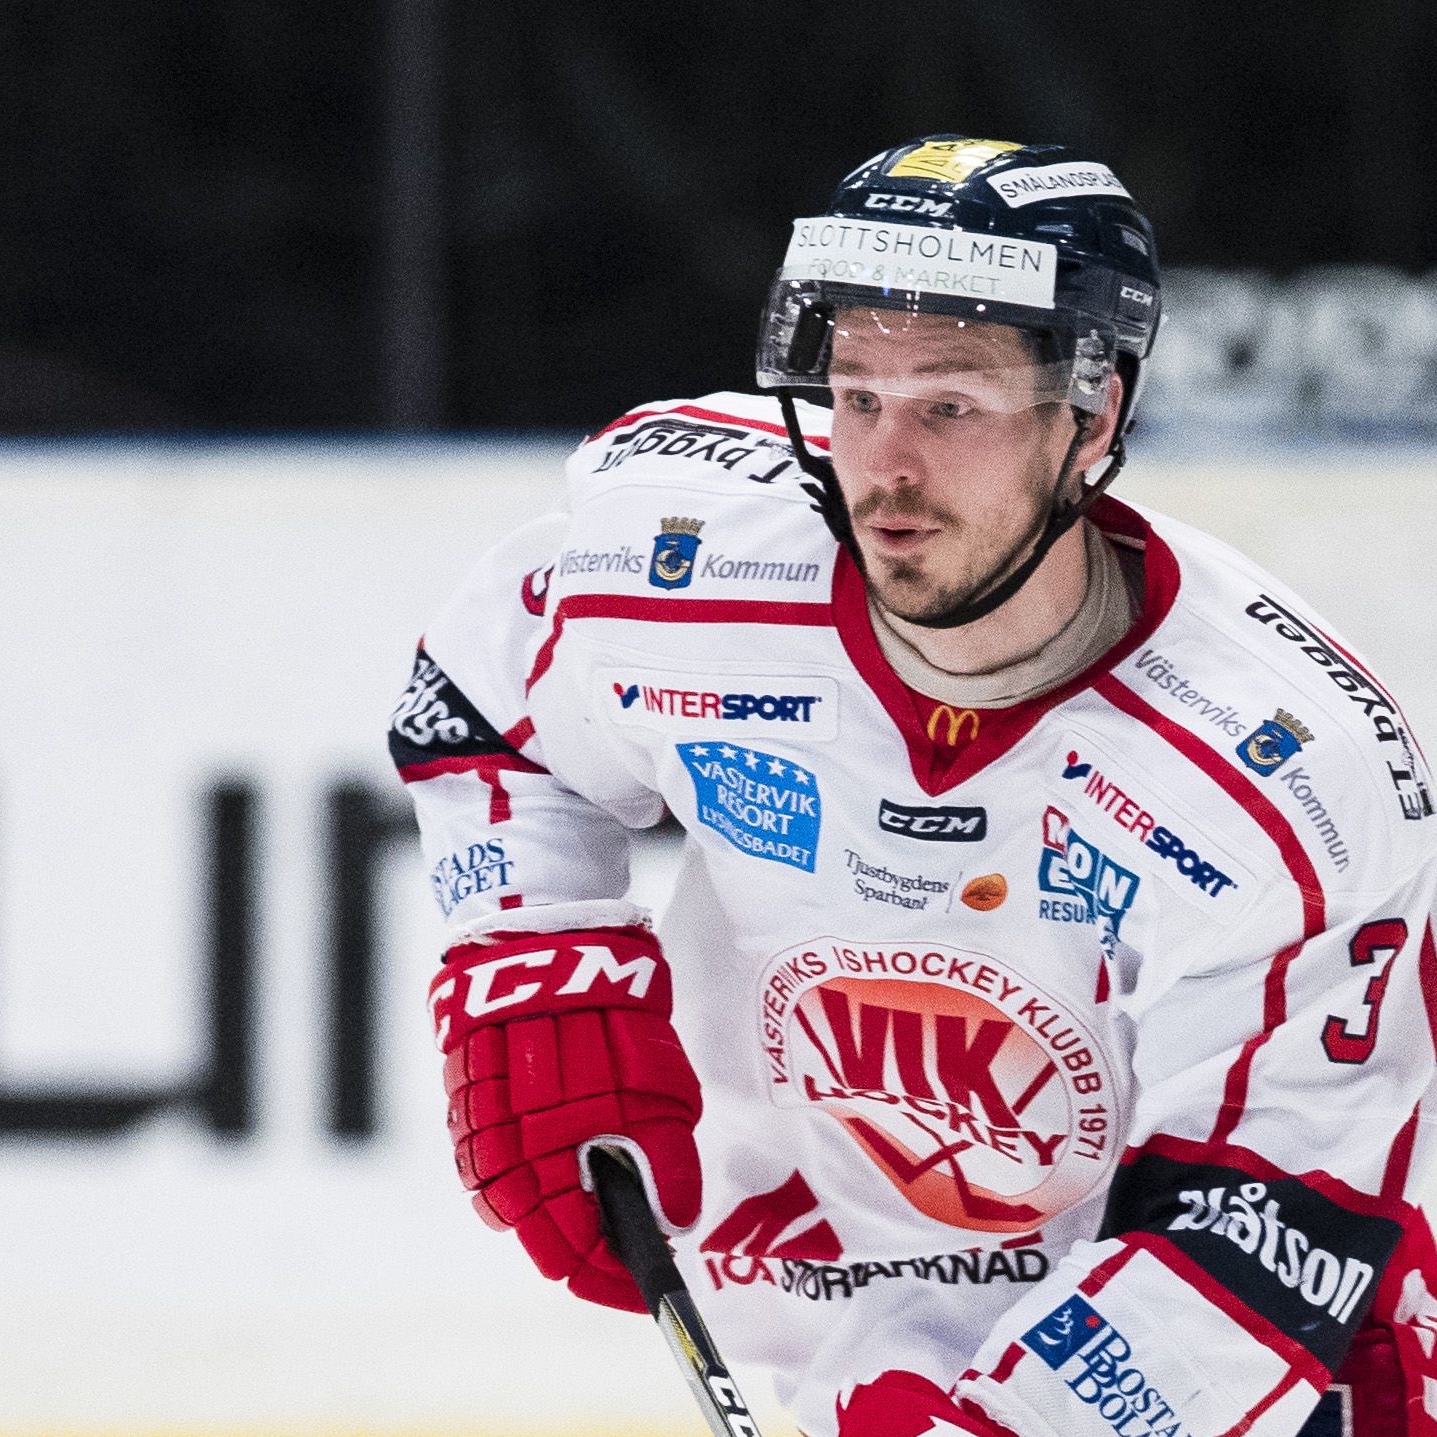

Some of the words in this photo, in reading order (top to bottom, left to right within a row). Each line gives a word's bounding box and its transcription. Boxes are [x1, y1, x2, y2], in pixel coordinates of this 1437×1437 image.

[864, 193, 954, 217] CCM
[797, 224, 1042, 272] SLOTTSHOLMEN
[894, 266, 1002, 295] MARKET
[1120, 285, 1154, 307] CCM
[700, 553, 820, 582] Kommun
[643, 685, 817, 723] INTERSPORT
[1134, 647, 1248, 738] Västerviks
[1279, 766, 1351, 875] Kommun
[692, 761, 817, 818] VÄSTERVIK
[717, 783, 794, 835] RESORT
[879, 808, 982, 834] CCM
[1085, 769, 1234, 899] INTERSPORT
[1320, 917, 1409, 1065] 3
[831, 945, 1023, 1003] ISHOCKEY
[1017, 996, 1104, 1096] KLUBB
[1072, 1105, 1109, 1163] 1971
